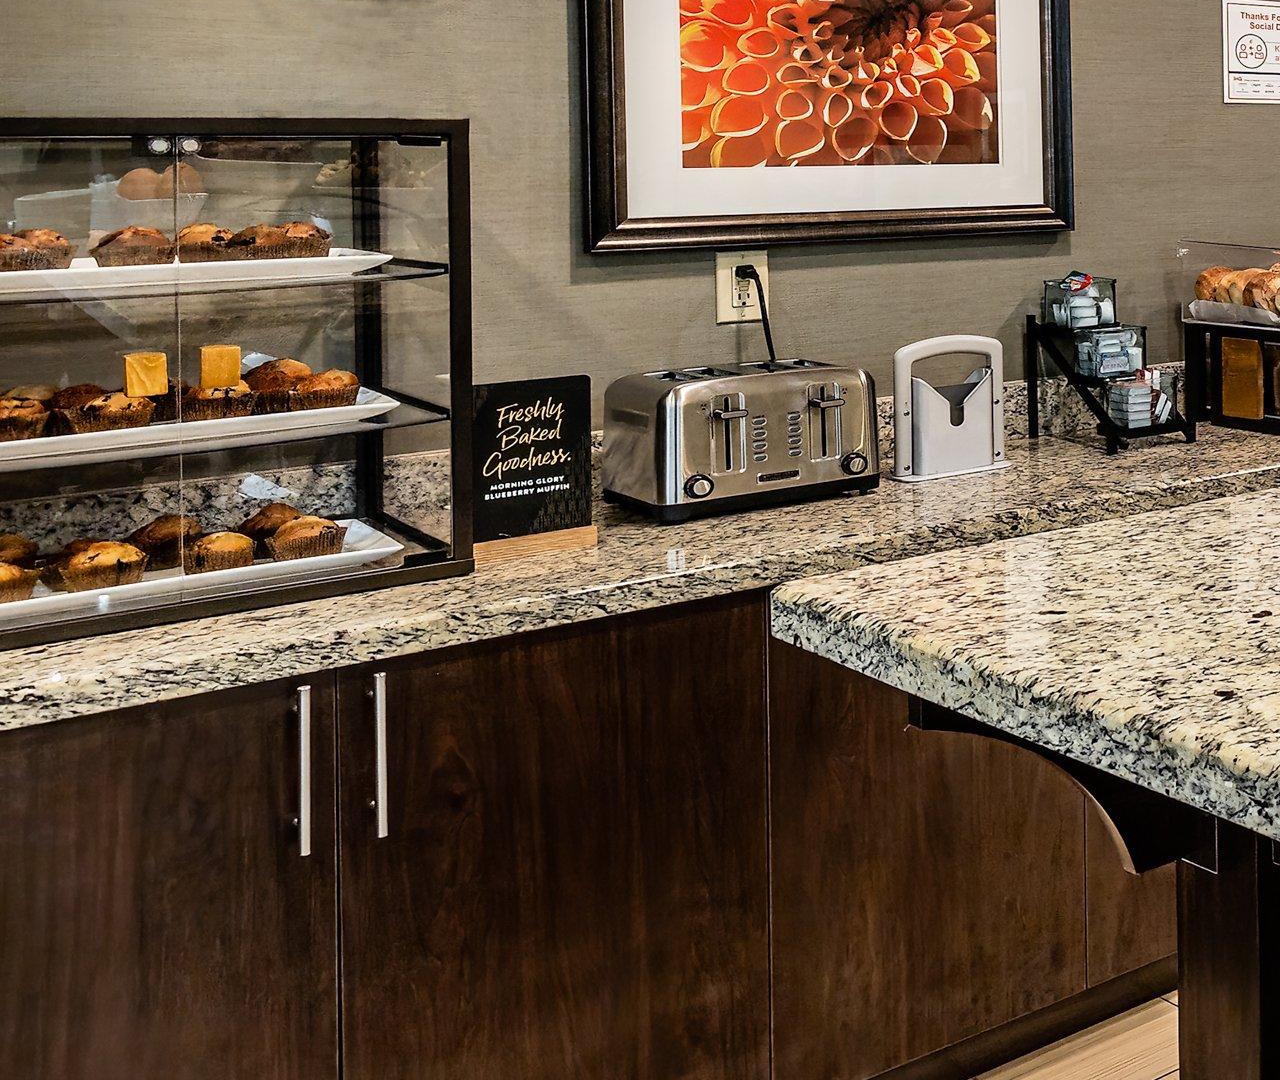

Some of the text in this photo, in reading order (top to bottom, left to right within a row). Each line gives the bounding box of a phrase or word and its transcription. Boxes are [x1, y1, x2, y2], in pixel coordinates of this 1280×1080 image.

[1240, 11, 1269, 20] Thanks
[1249, 21, 1274, 30] Social
[496, 396, 564, 428] Freshly
[496, 418, 562, 451] Baked
[482, 446, 572, 479] Goodness.
[490, 475, 565, 490] MORNING GLORY
[484, 483, 569, 500] BLUEBERRY MUFFIN
